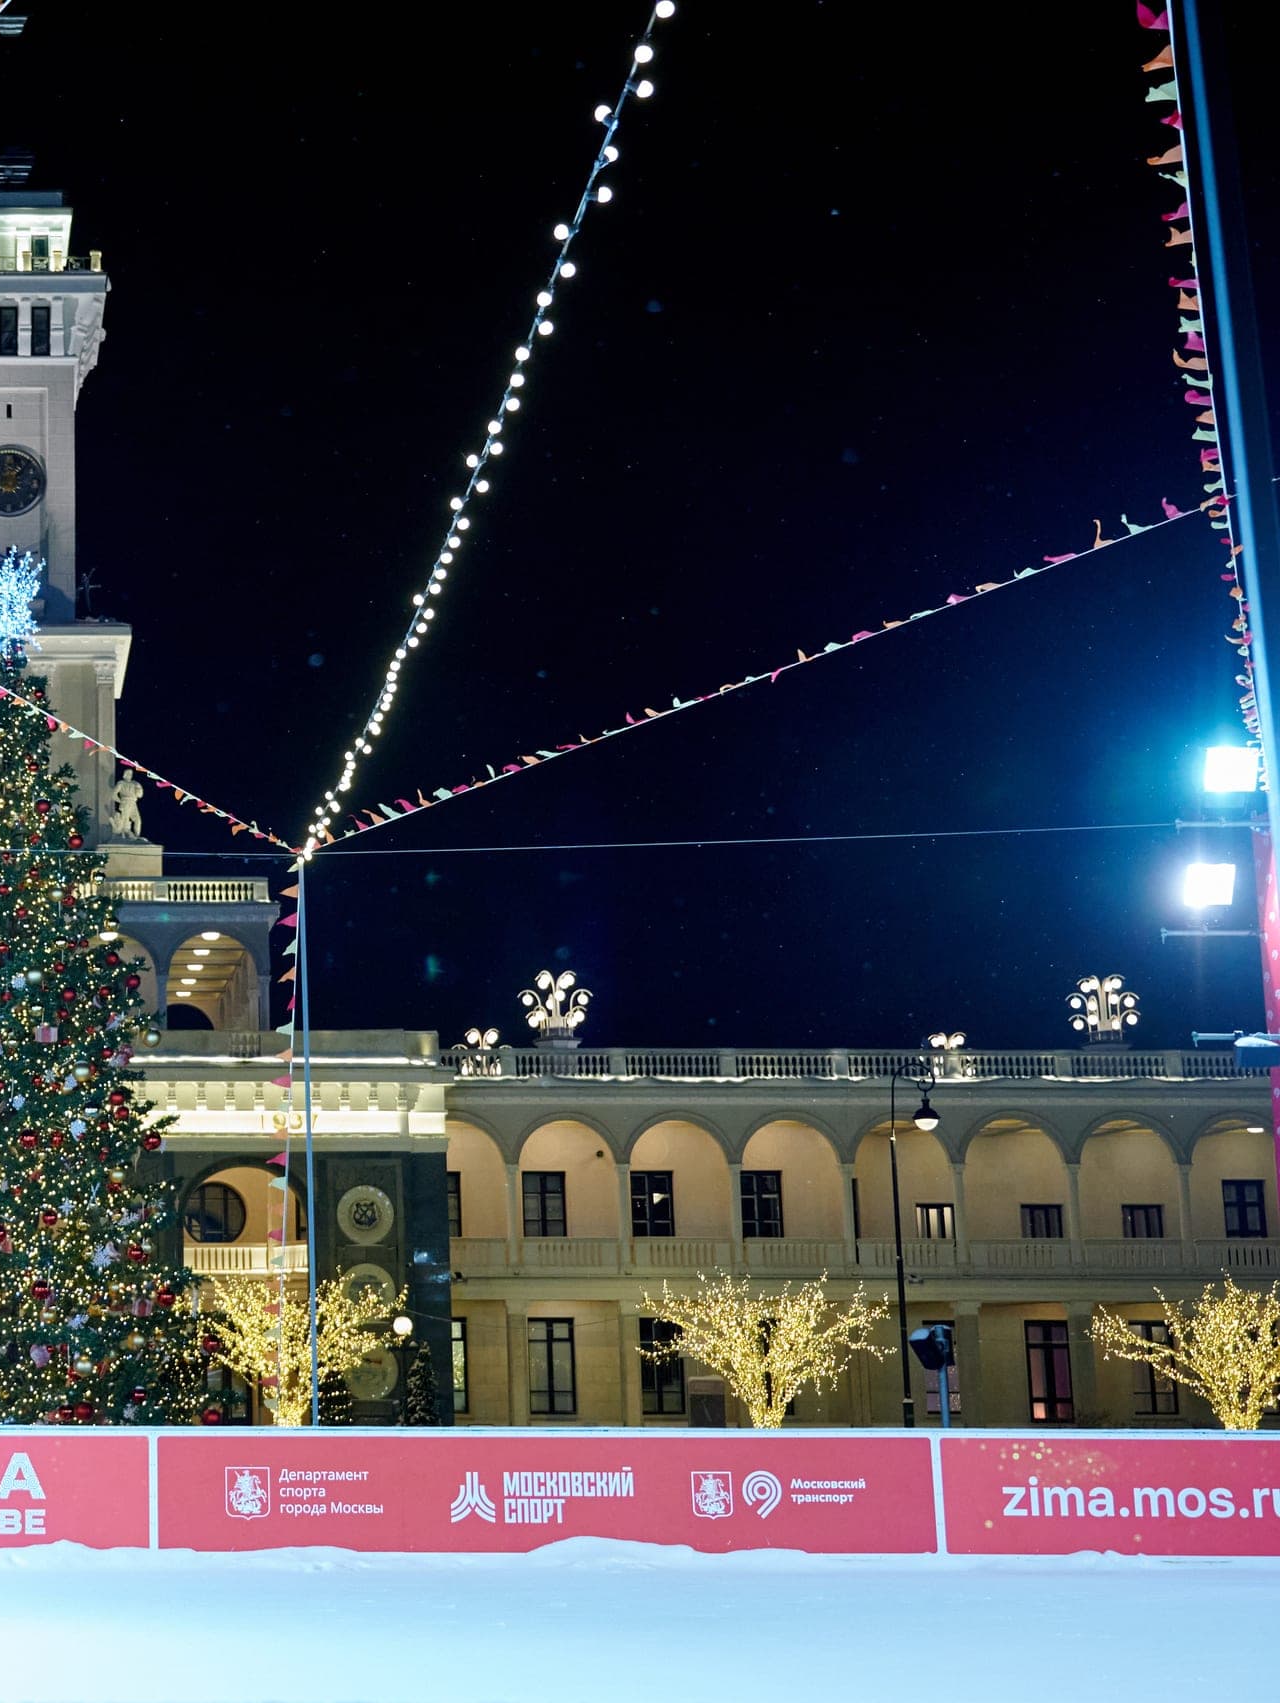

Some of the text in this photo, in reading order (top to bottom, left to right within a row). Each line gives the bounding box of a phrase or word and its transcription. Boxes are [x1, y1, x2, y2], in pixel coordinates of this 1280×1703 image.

[279, 1469, 369, 1483] Департамент
[503, 1466, 634, 1497] МОСКОВСКИЙ
[790, 1478, 866, 1489] Московский
[279, 1486, 326, 1500] спорта
[791, 1494, 853, 1504] транспорт
[280, 1502, 384, 1516] города Москвы
[504, 1499, 565, 1523] СПОРТ
